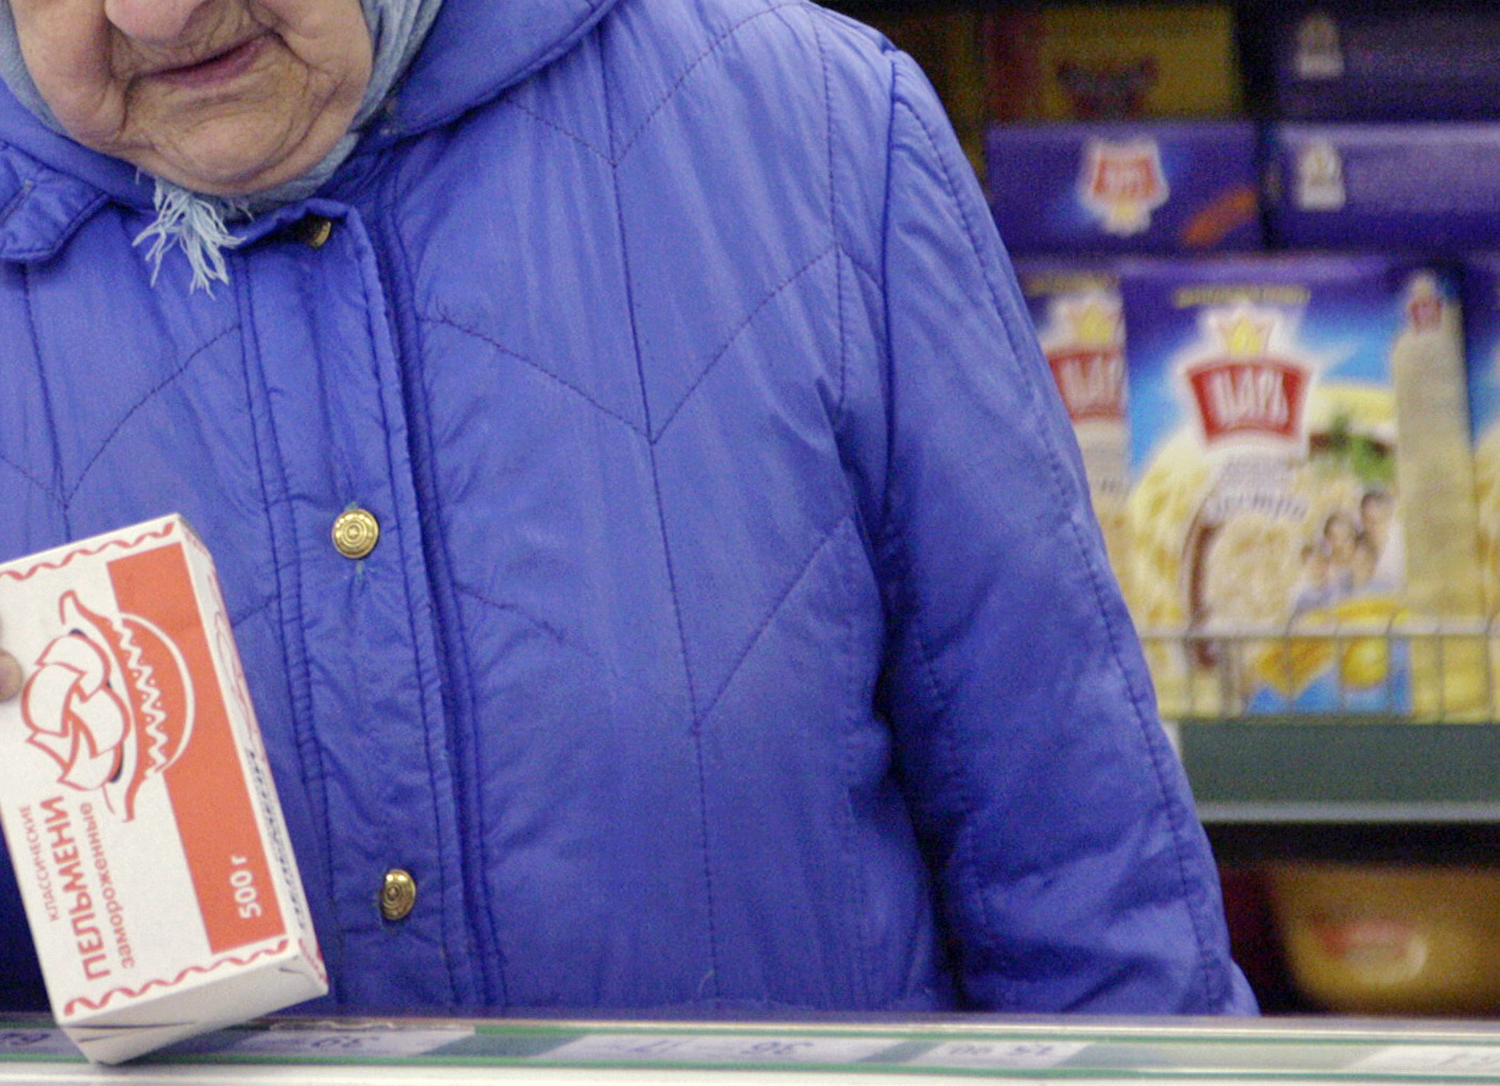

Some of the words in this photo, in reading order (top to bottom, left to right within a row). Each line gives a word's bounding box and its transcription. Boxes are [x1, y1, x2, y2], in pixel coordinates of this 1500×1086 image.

[19, 804, 60, 923] КЛАССИЧЕСКИЕ
[40, 795, 112, 982] ПЕЛЬМЕНИ
[79, 802, 135, 969] замороженные
[230, 870, 262, 920] 500
